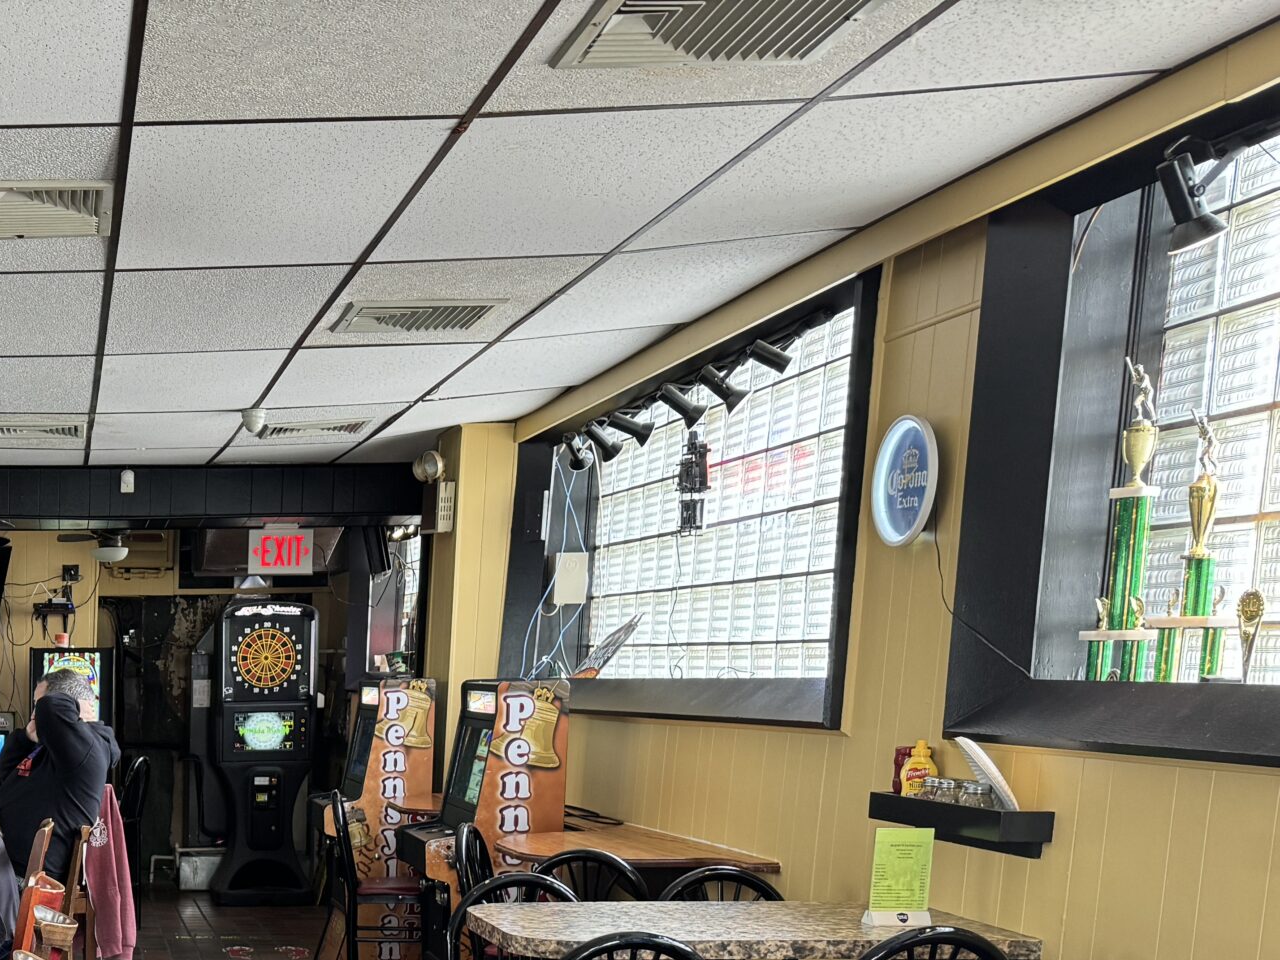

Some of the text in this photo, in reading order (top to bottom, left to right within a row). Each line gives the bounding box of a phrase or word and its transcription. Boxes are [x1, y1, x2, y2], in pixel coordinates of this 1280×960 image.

[887, 469, 928, 498] Corona
[896, 491, 919, 509] Extra
[260, 534, 305, 568] EXIT
